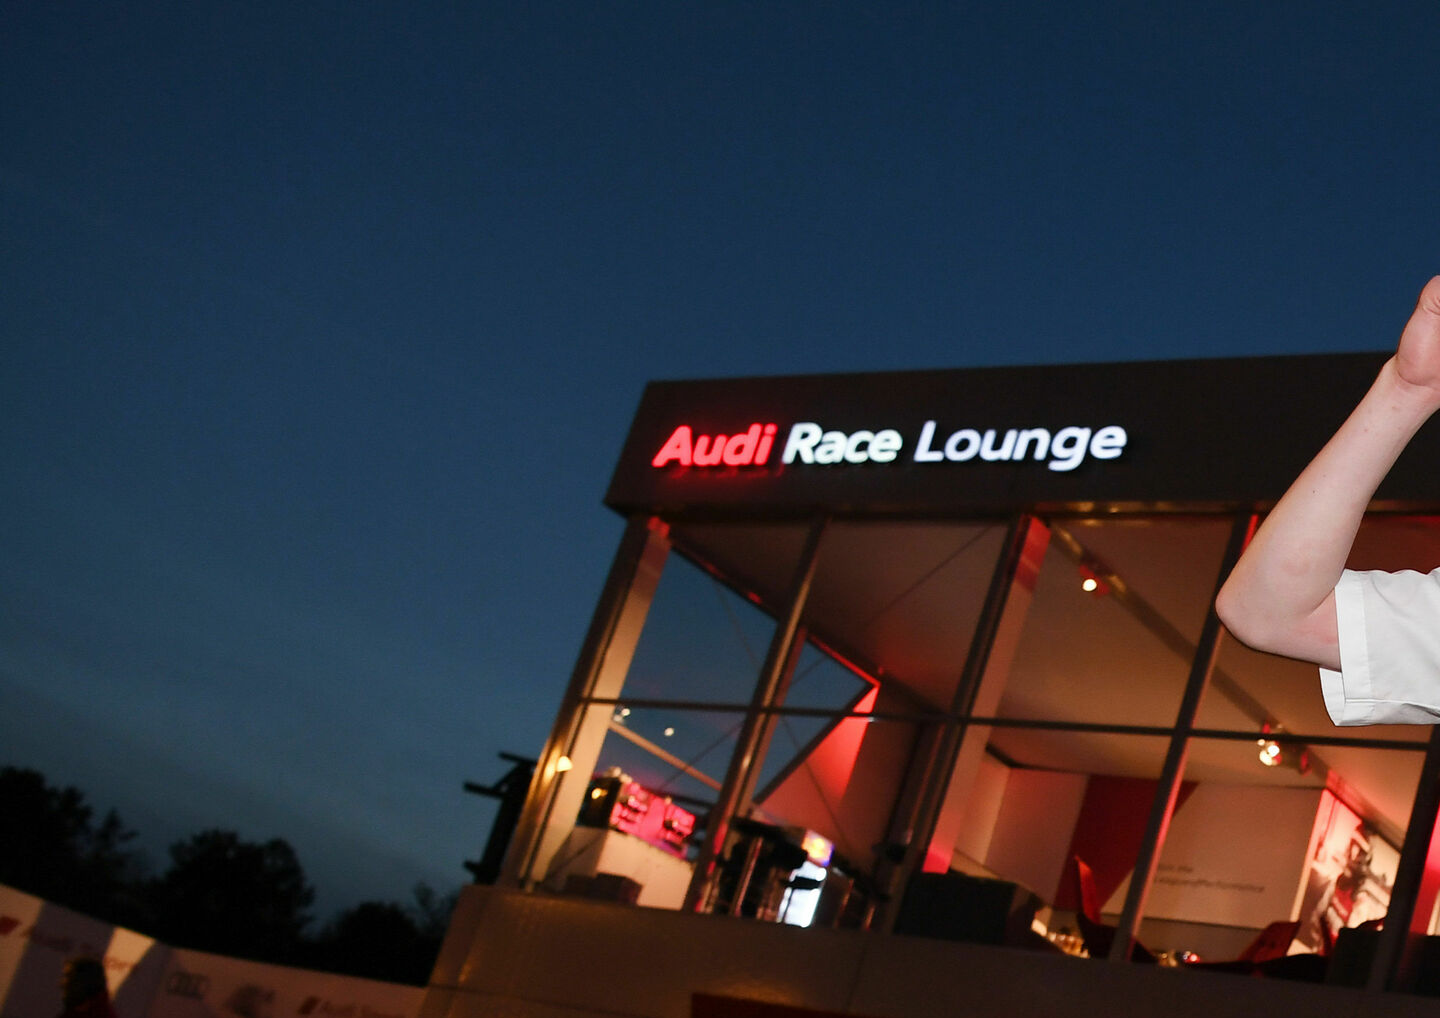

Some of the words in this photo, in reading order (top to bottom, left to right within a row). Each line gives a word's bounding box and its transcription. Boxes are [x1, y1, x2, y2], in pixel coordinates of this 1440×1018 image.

[652, 423, 778, 467] Audi
[782, 421, 903, 465] Race
[913, 419, 1128, 472] Lounge
